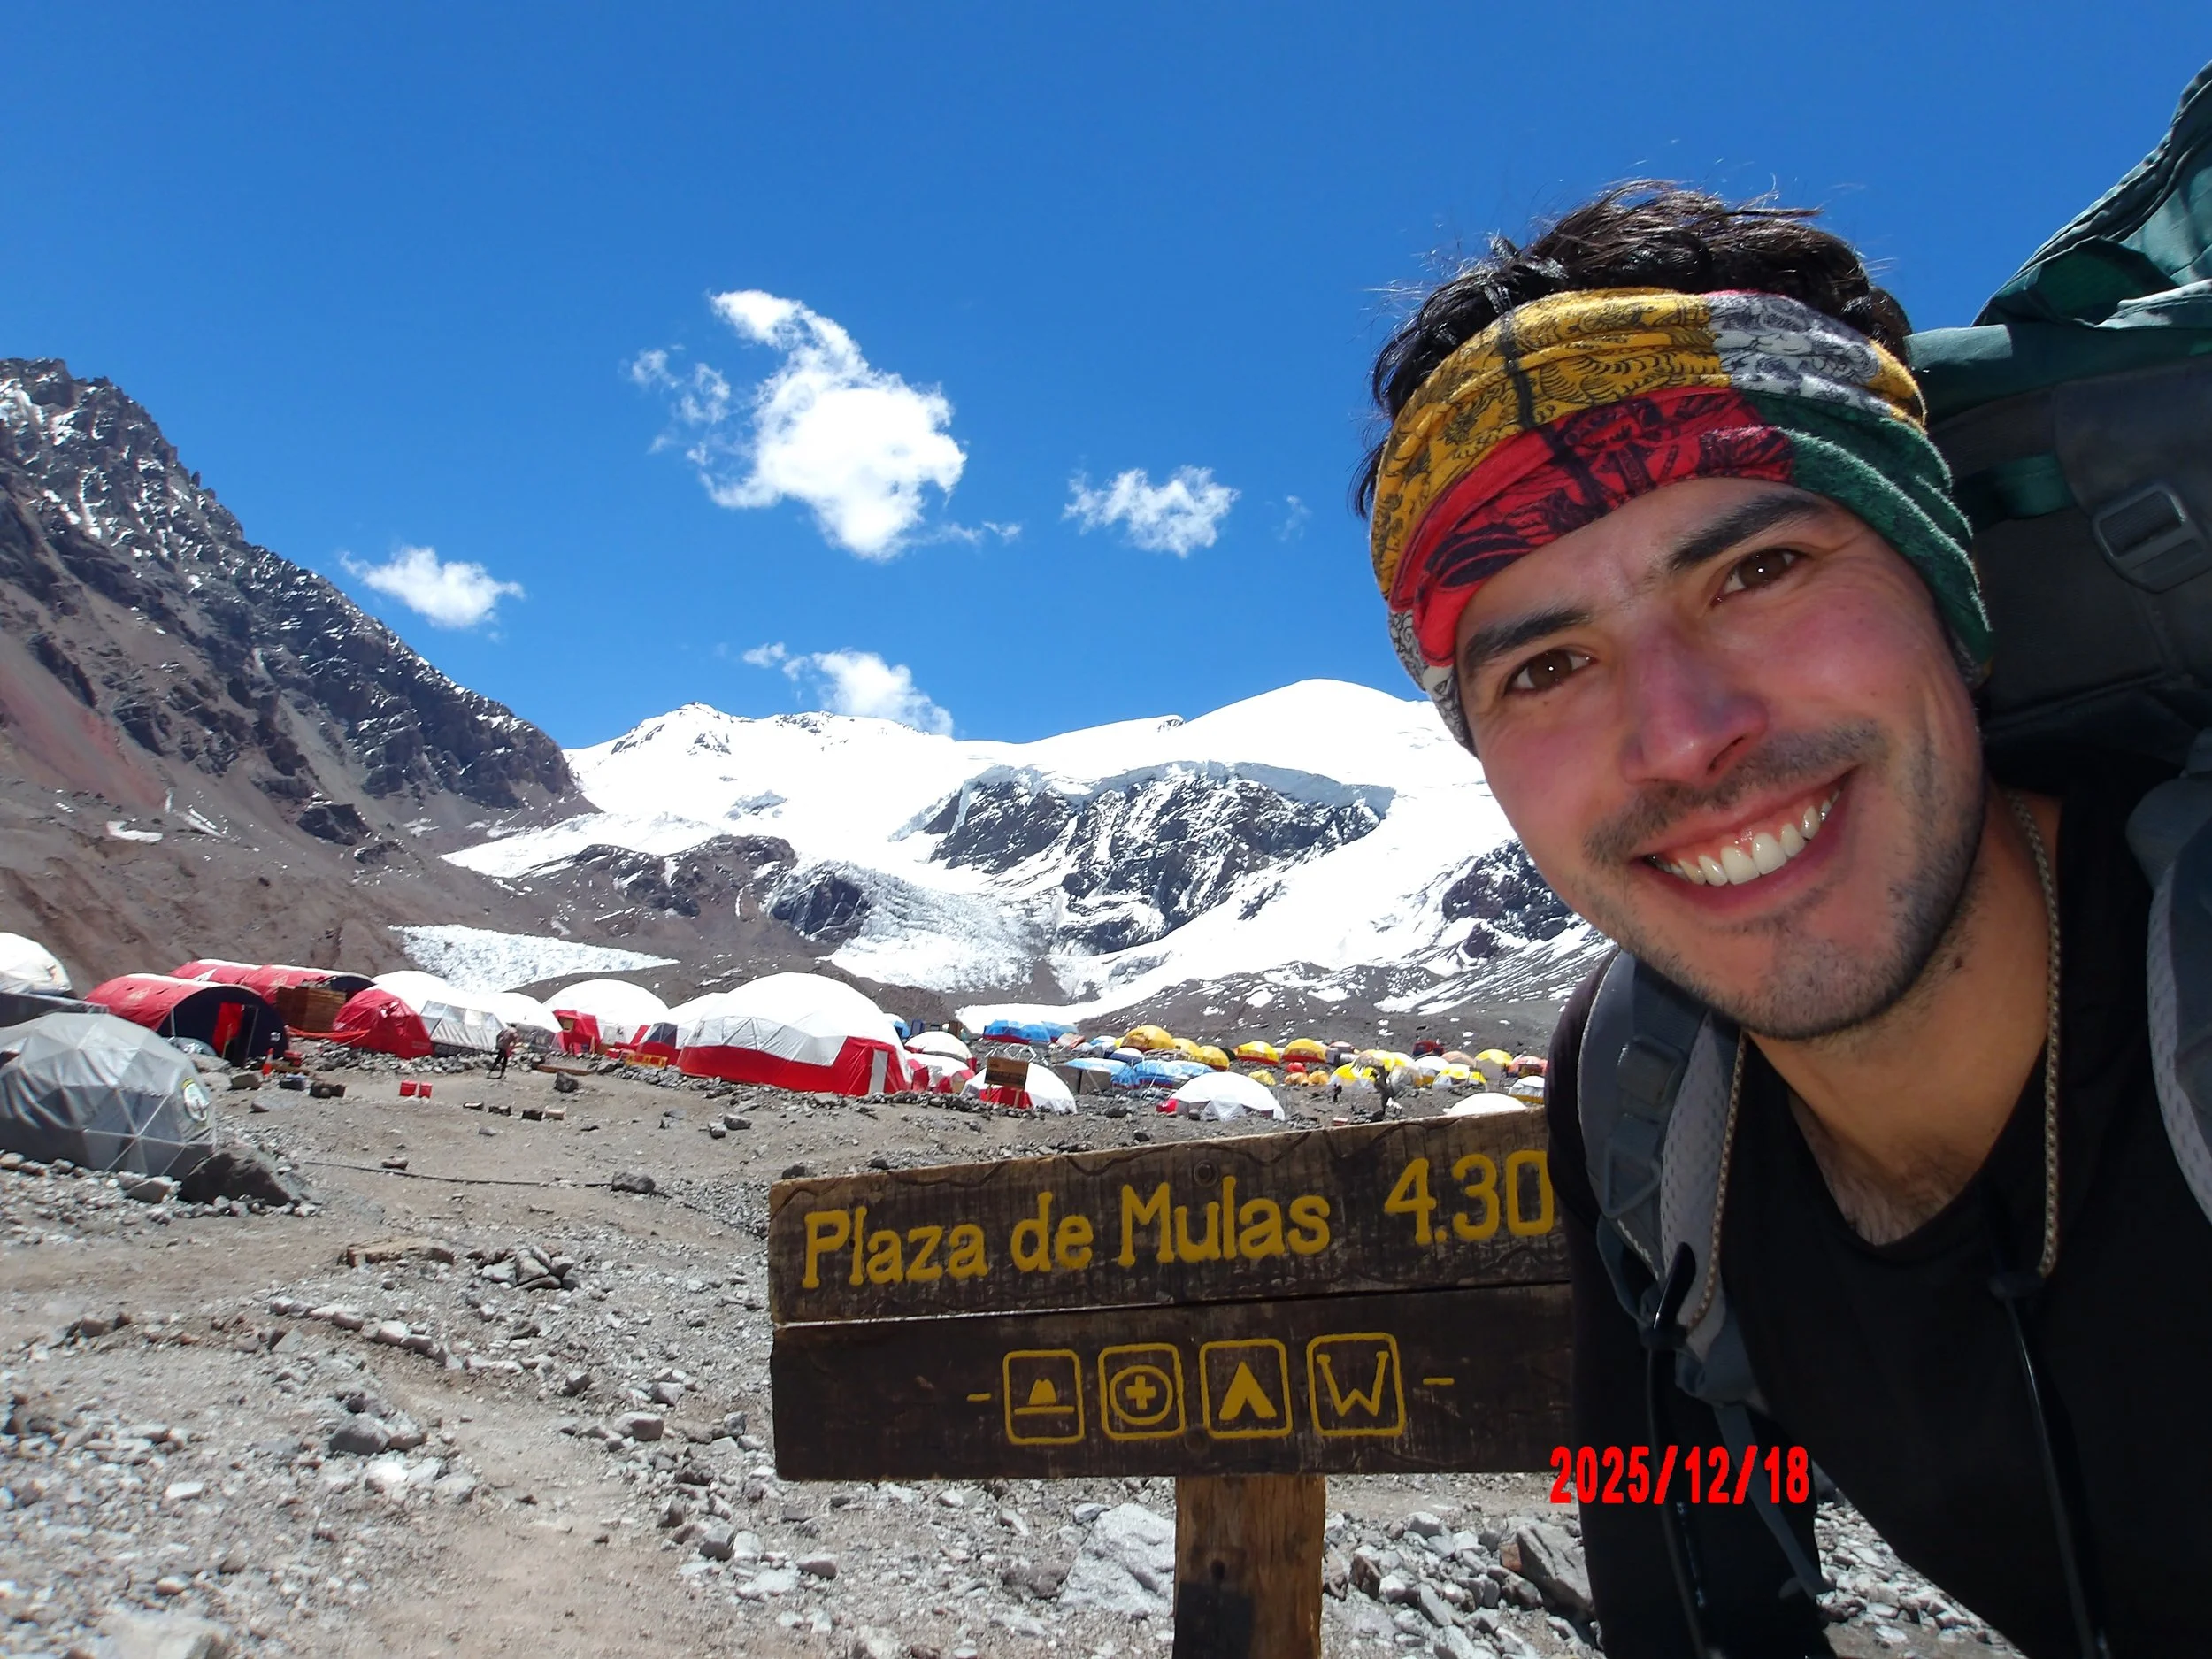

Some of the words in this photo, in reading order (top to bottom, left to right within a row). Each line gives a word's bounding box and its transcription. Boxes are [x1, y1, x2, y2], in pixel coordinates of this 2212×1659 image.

[802, 1206, 989, 1288] Plaza
[1010, 1191, 1094, 1272] de
[1118, 1175, 1331, 1267] Mulas
